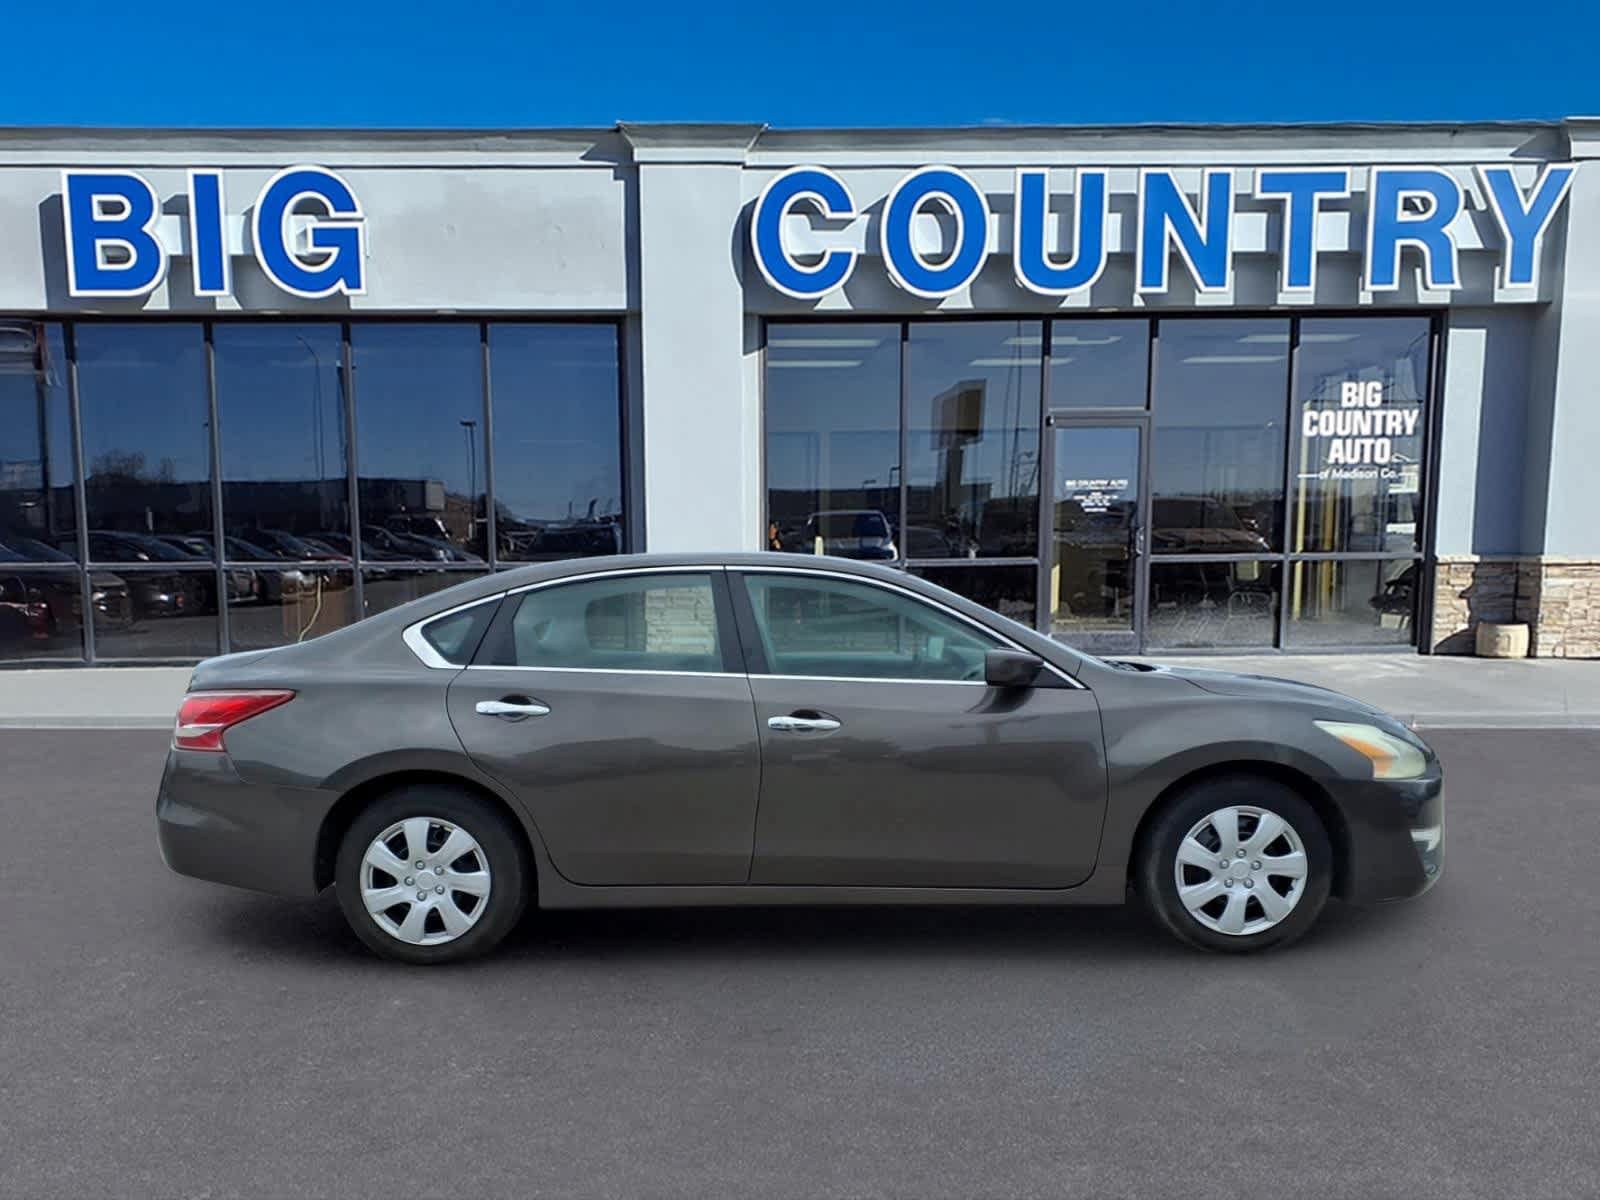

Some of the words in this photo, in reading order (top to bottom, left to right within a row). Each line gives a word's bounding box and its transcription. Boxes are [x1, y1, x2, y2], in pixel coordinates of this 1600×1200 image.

[61, 165, 367, 298] BIG
[750, 163, 1575, 300] COUNTRY
[1341, 381, 1382, 408] BIG
[1303, 409, 1419, 437] COUNTRY
[1328, 438, 1391, 465] AUTO
